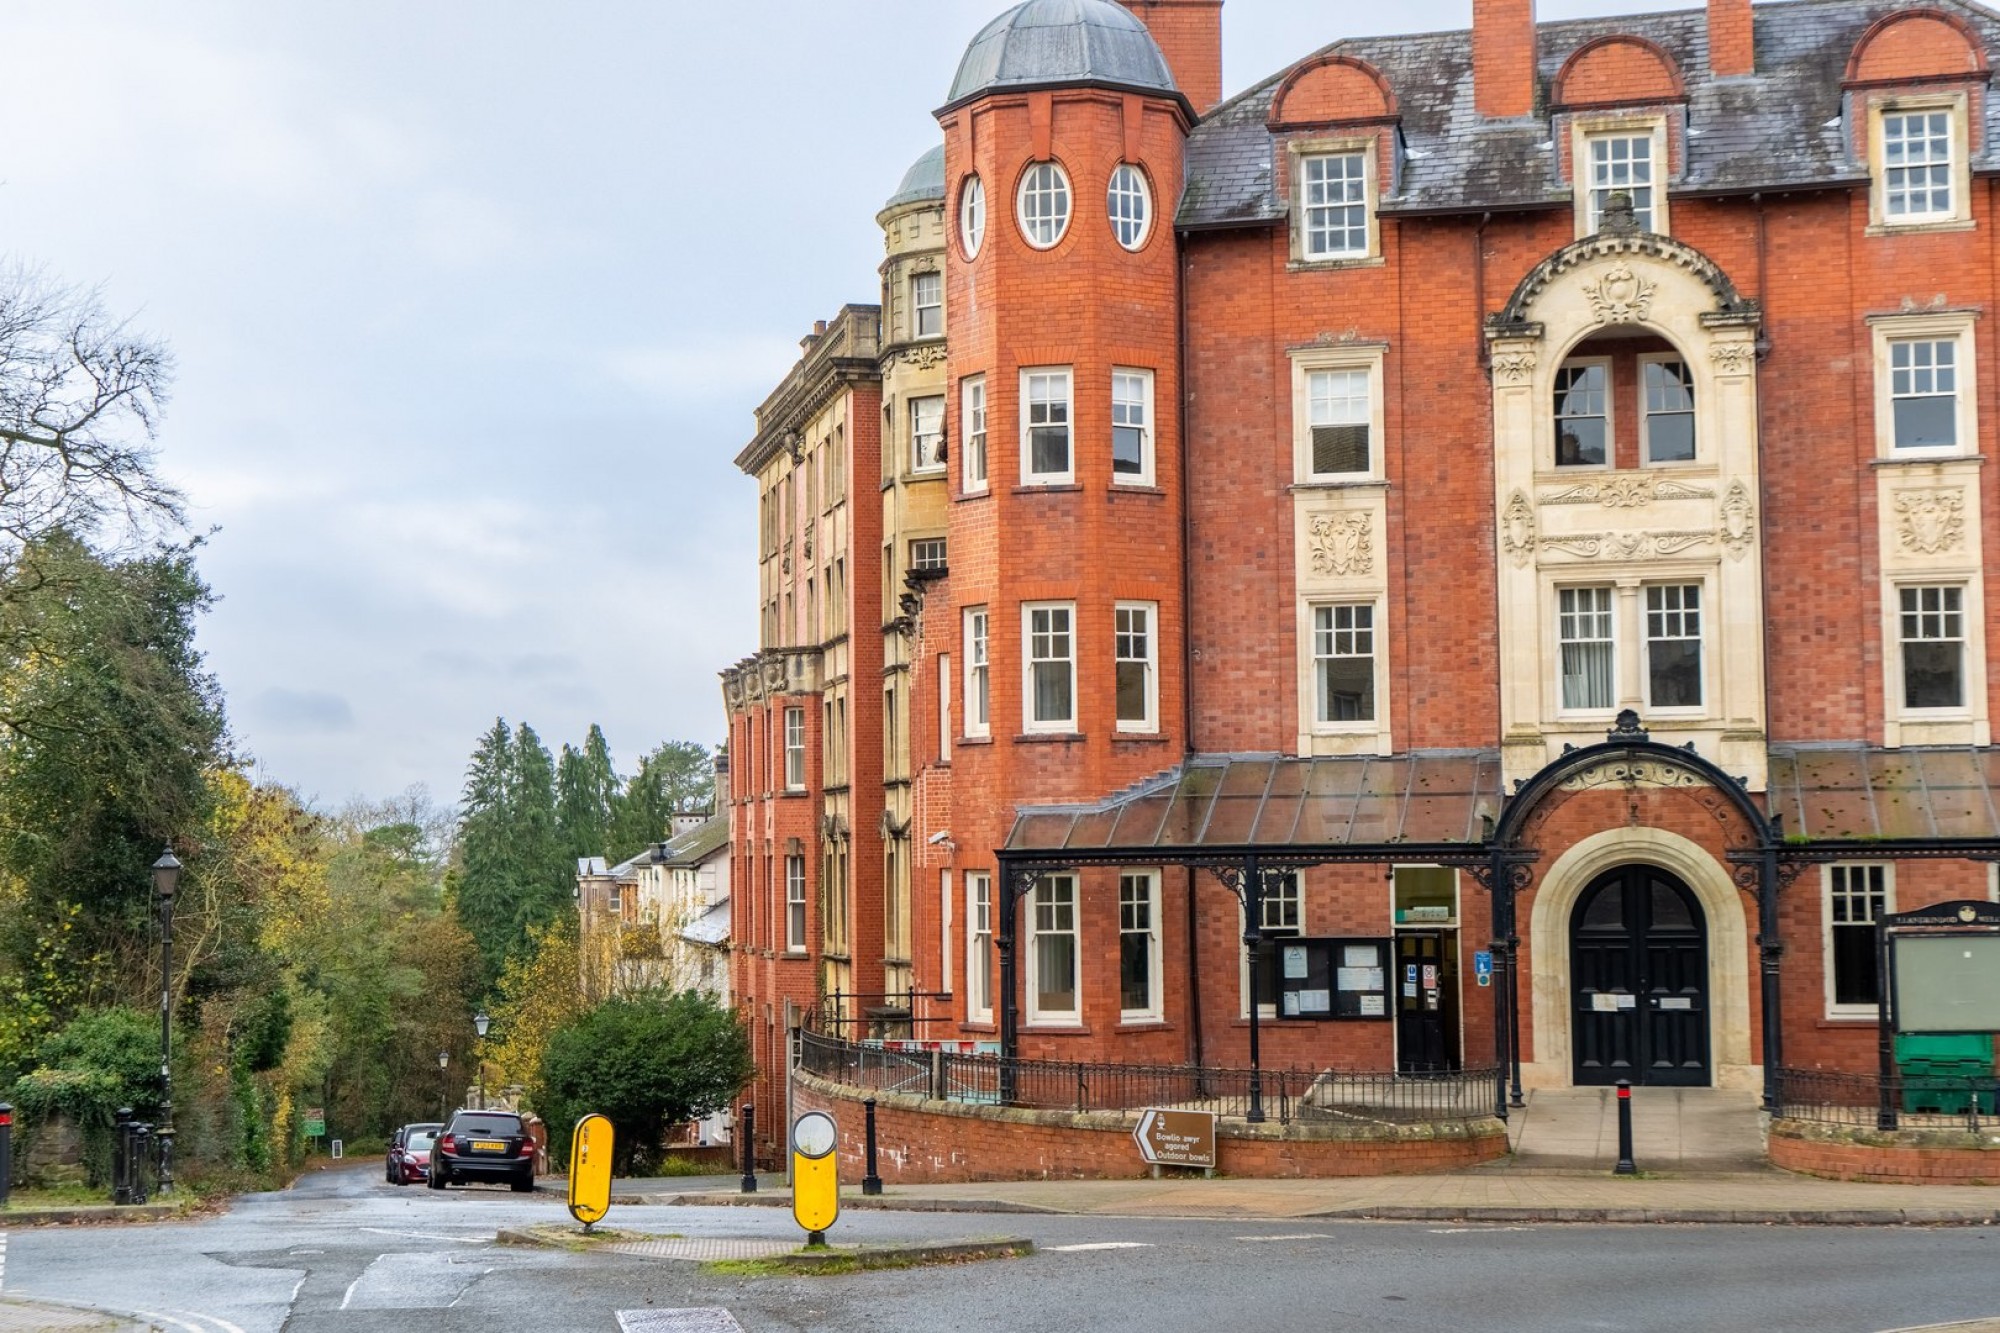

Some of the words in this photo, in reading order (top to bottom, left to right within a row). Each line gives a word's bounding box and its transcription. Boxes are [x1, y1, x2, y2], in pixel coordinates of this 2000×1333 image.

[1156, 1133, 1180, 1142] Bowlio
[1157, 1151, 1186, 1159] Outdoor
[1189, 1153, 1210, 1161] bowls
